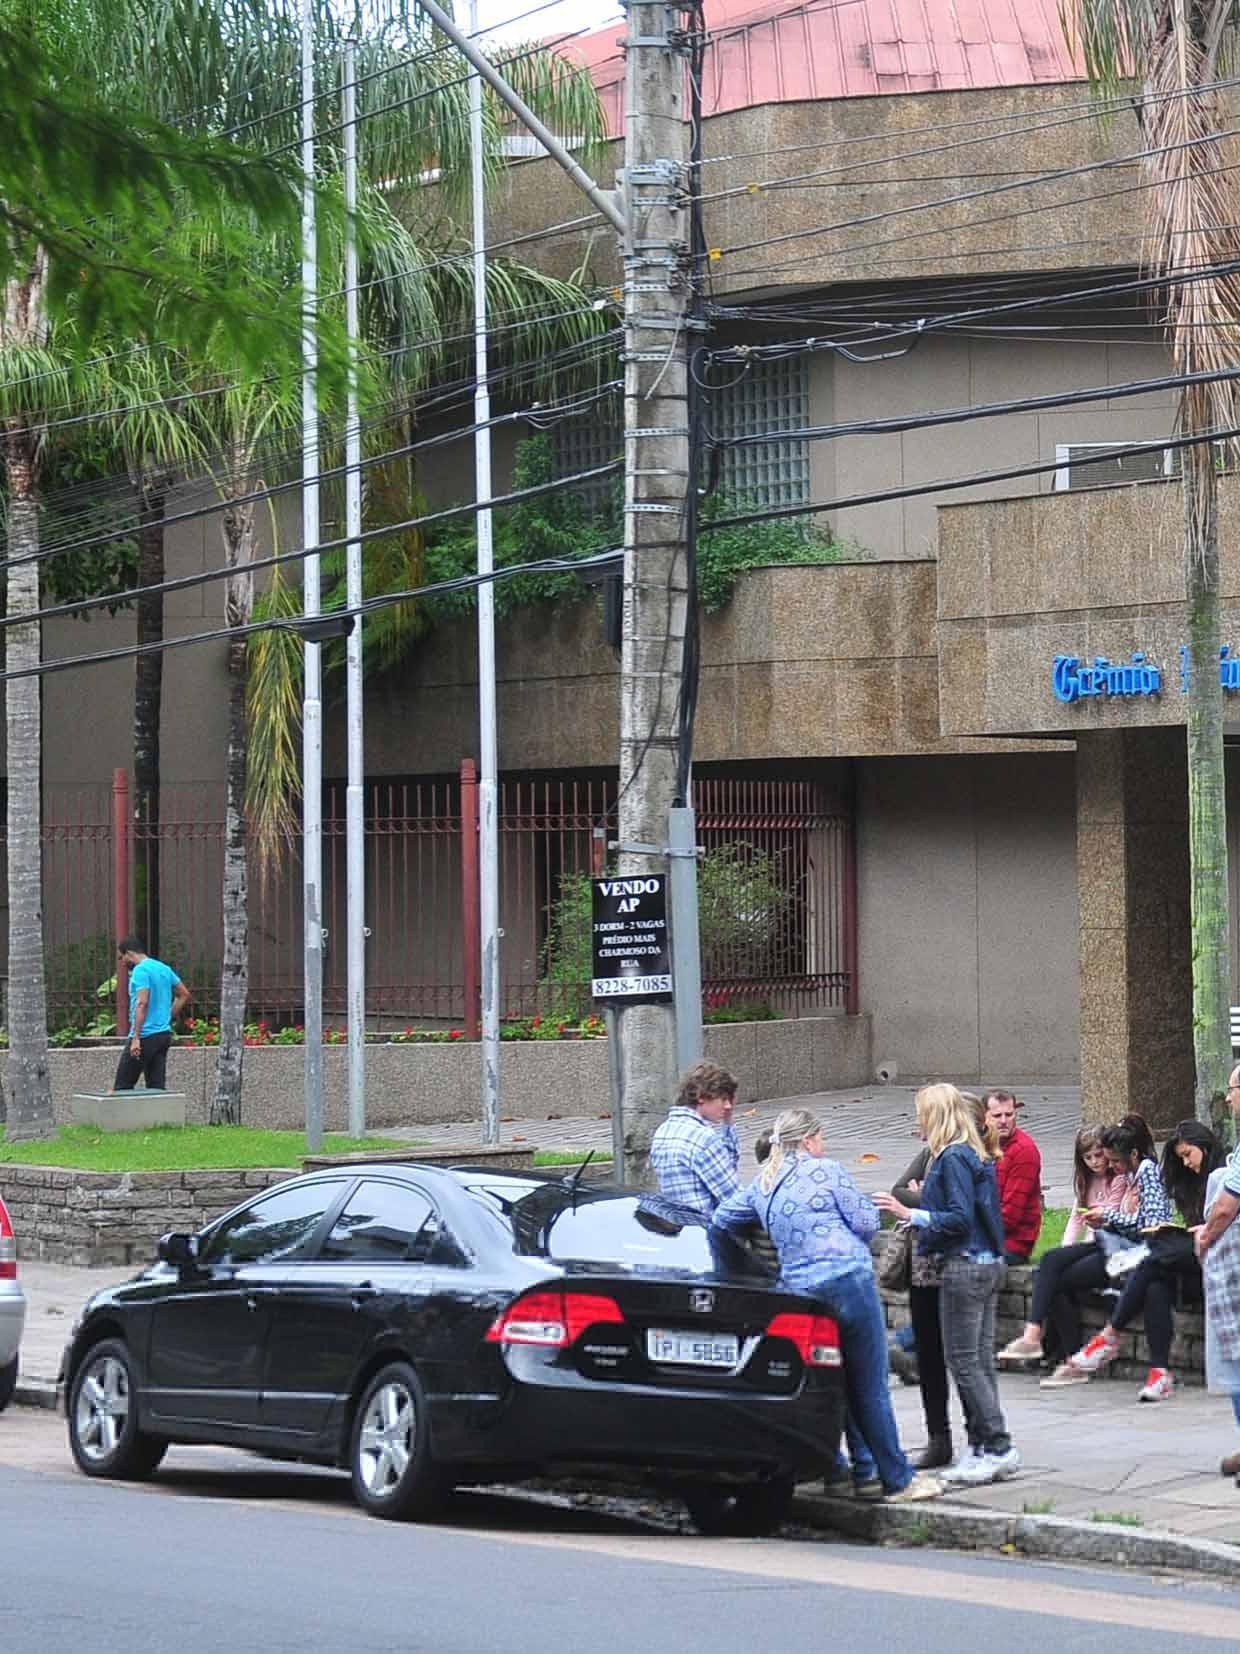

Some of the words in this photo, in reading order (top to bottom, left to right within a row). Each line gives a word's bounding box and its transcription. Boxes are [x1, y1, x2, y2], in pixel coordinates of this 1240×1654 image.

[598, 879, 660, 896] VENDO
[617, 898, 640, 913] AP
[637, 919, 665, 929] VAGAS
[634, 933, 656, 942] MAIS
[647, 946, 661, 955] DA
[595, 977, 669, 994] 8228-7085
